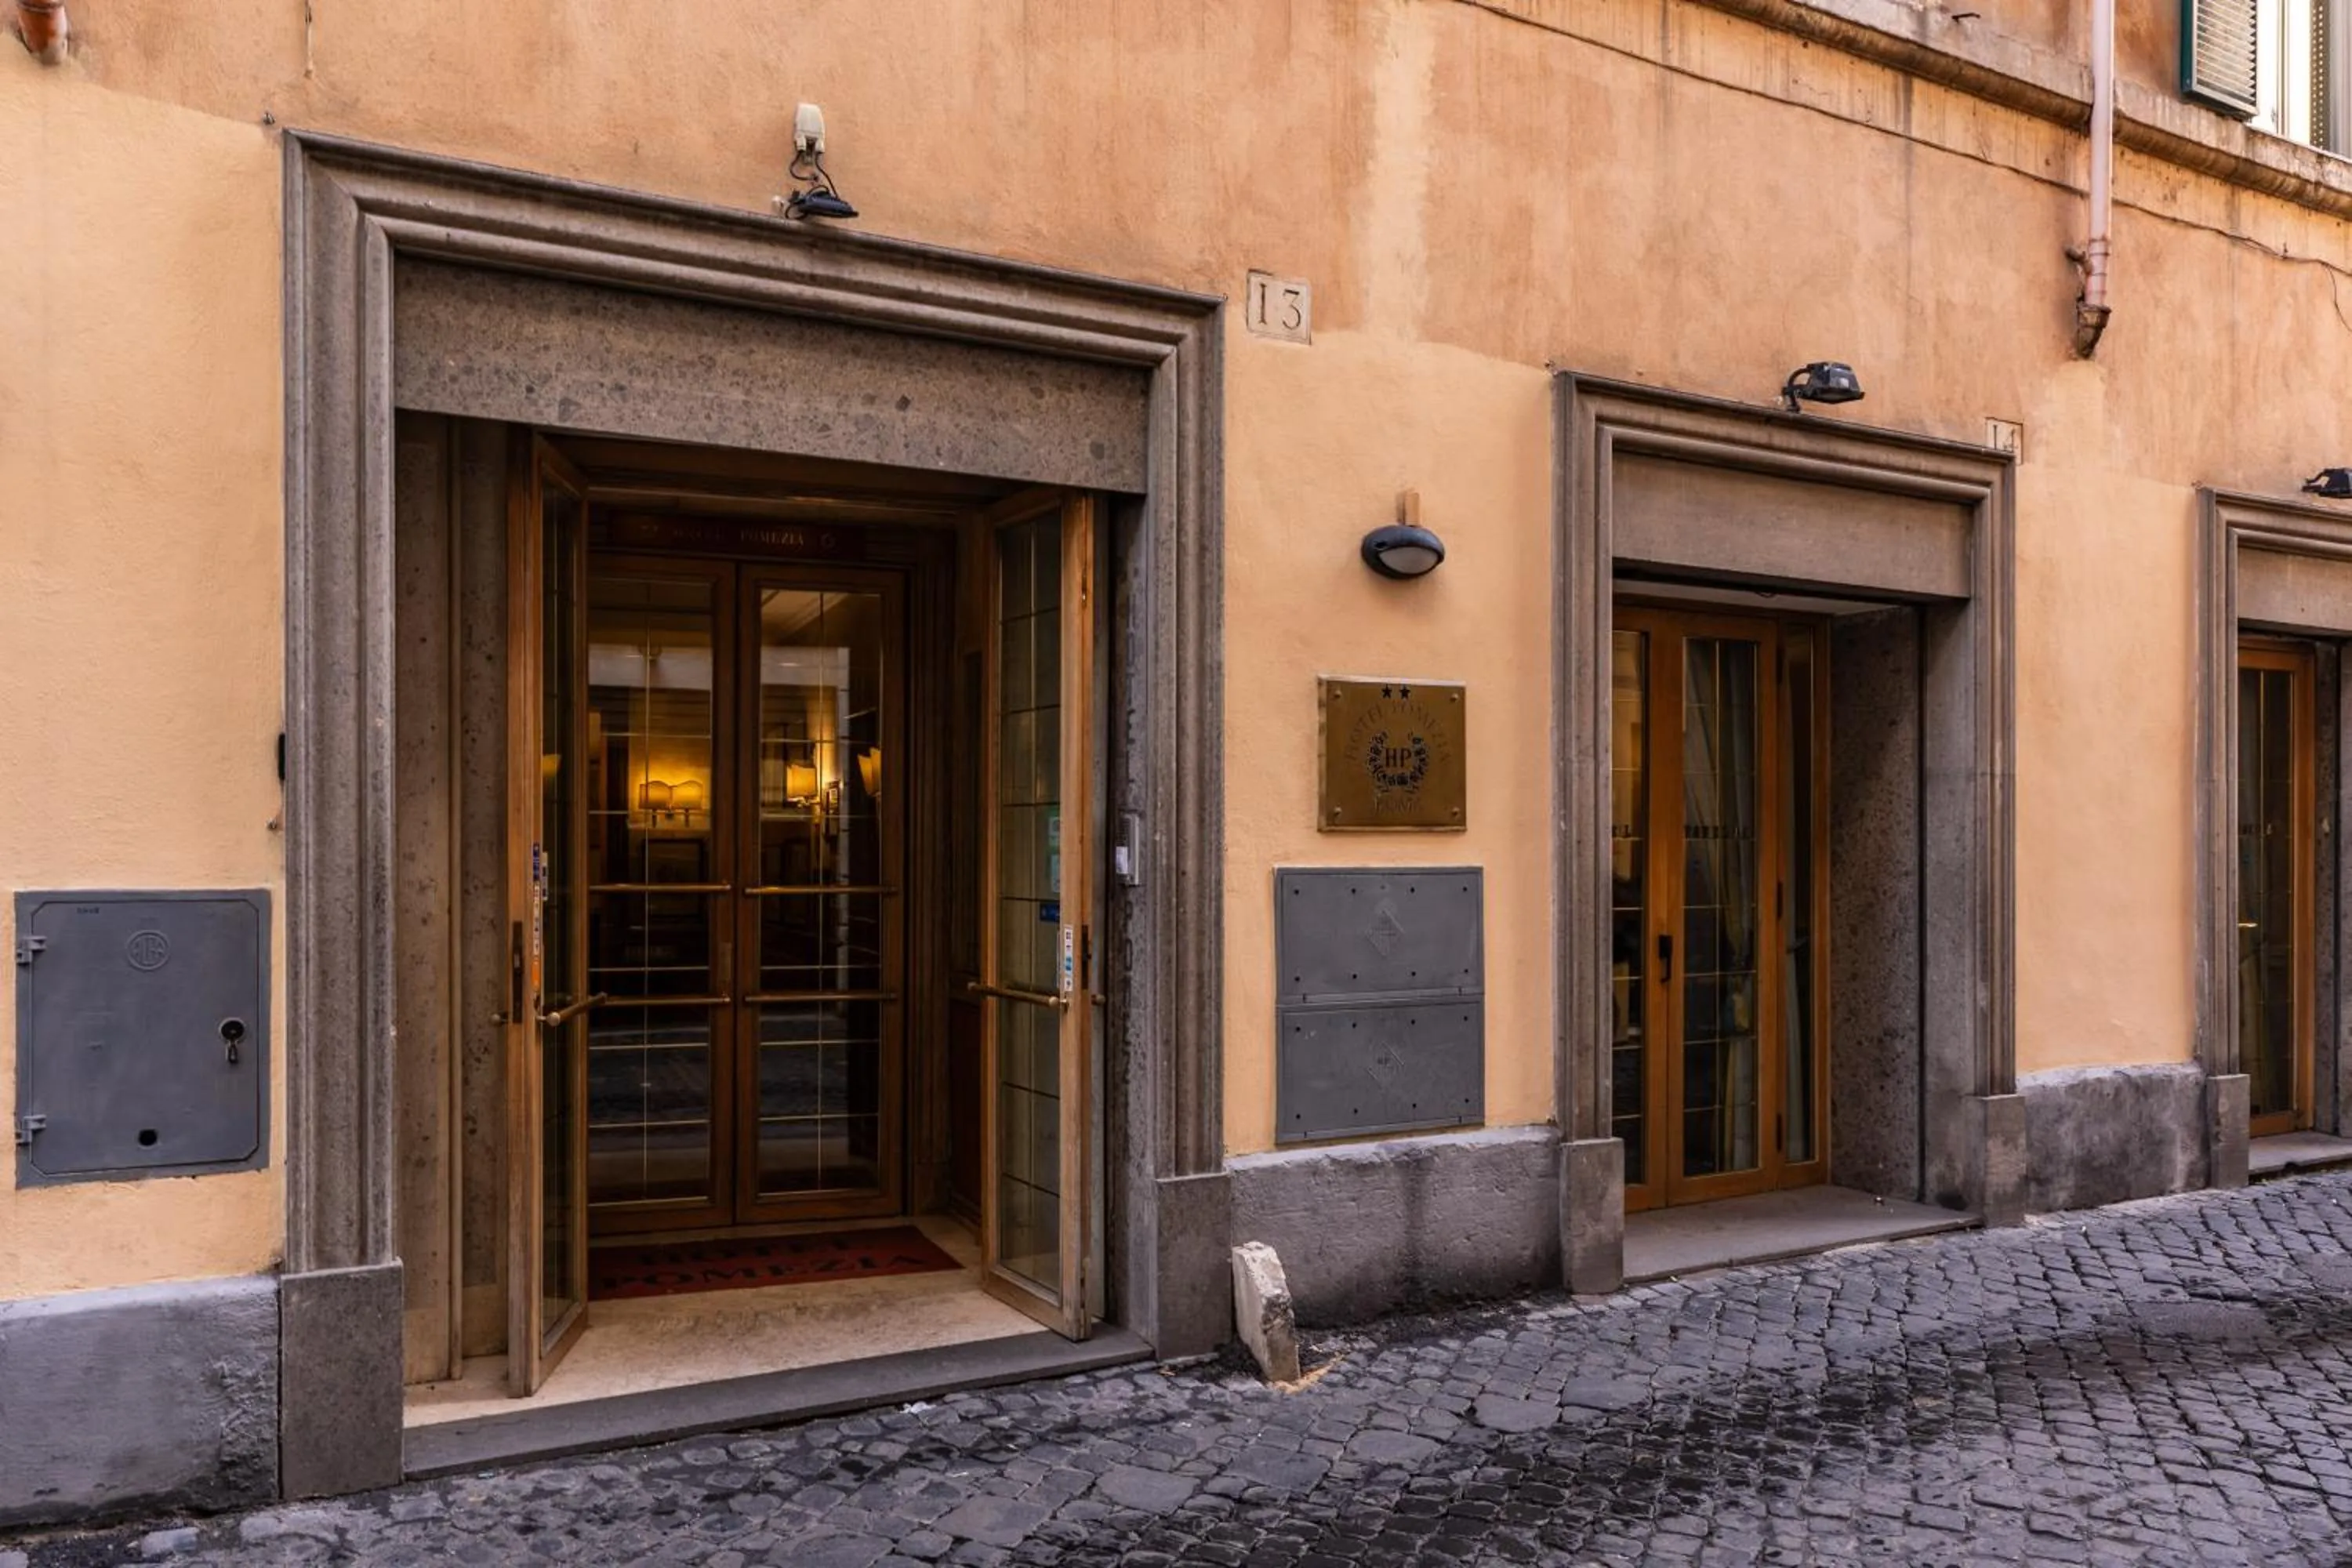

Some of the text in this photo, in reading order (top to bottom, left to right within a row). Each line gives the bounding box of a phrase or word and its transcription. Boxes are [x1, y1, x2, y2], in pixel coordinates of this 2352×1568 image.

[1259, 283, 1301, 330] 13
[1385, 747, 1412, 768] HP
[601, 1254, 926, 1290] POMEZIA
